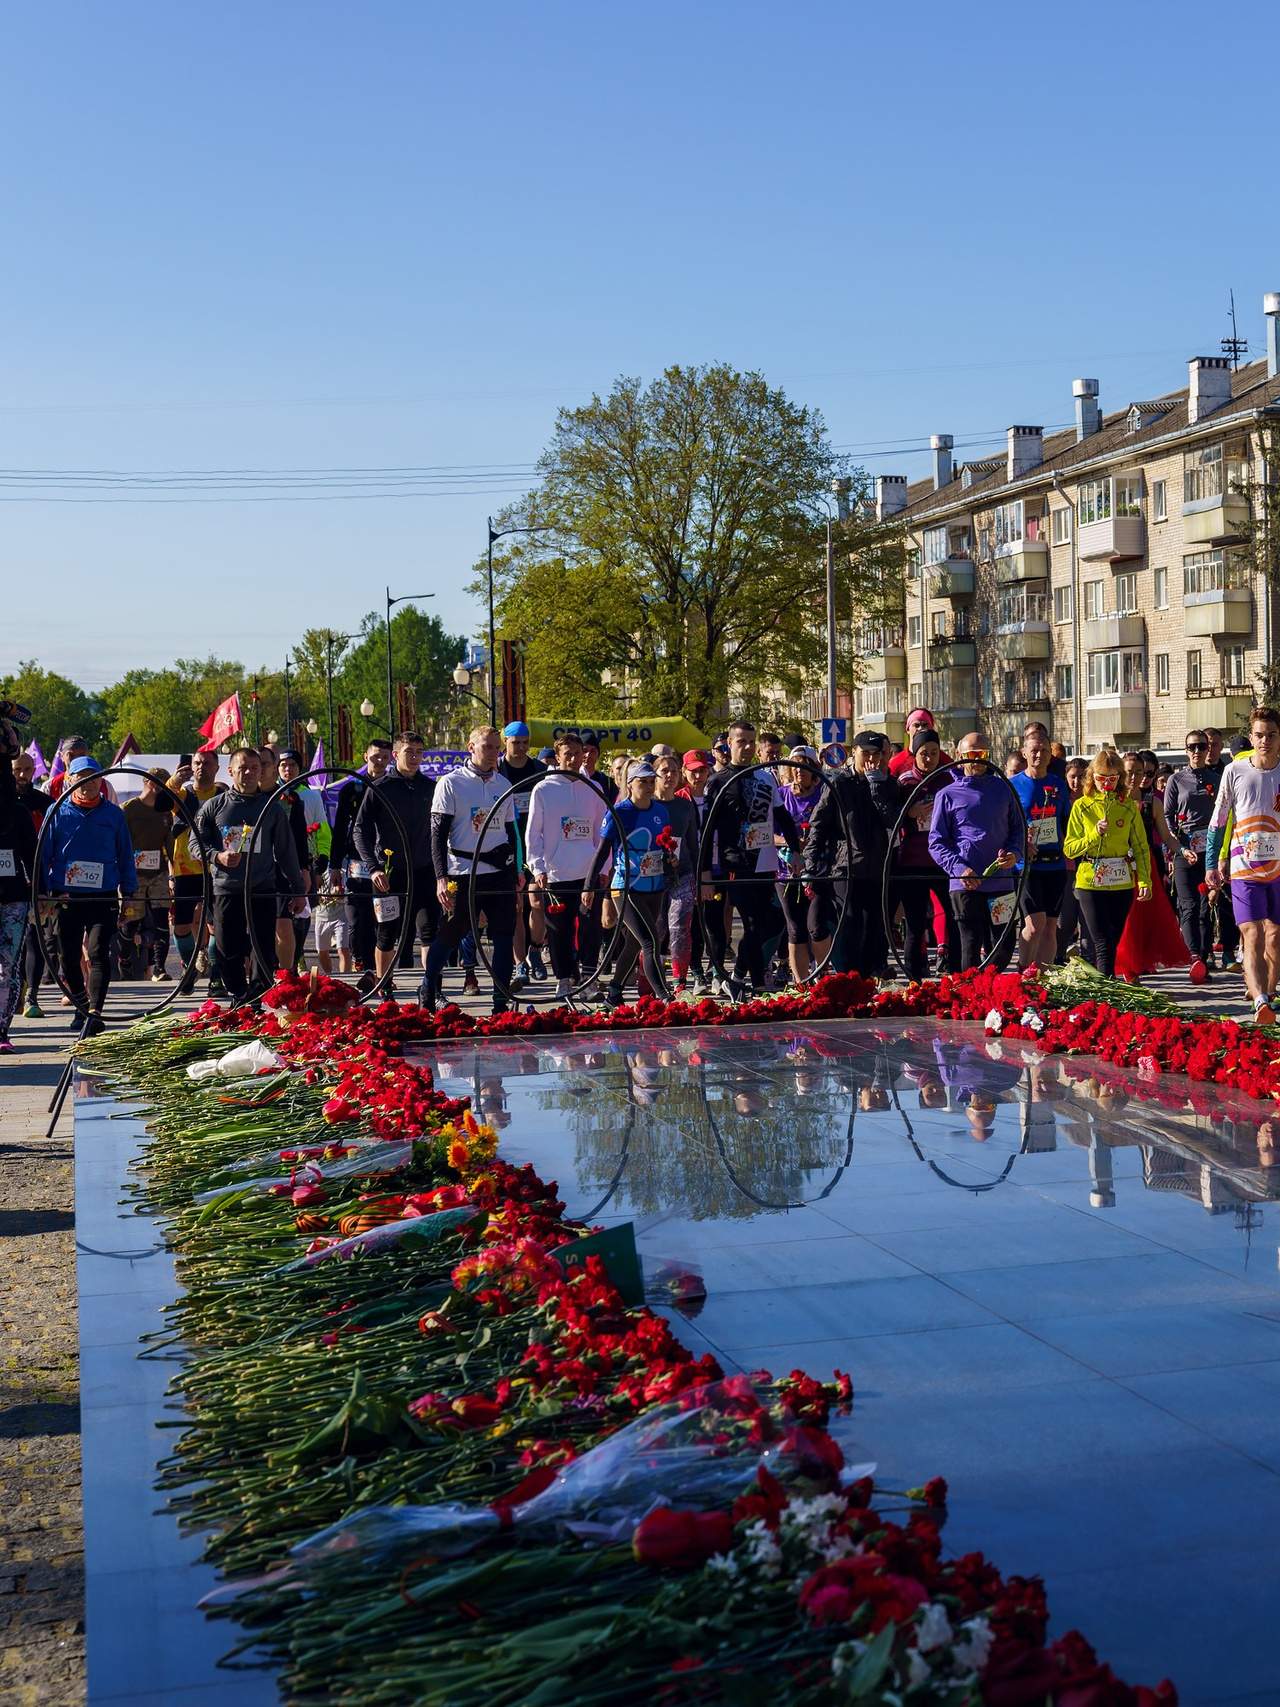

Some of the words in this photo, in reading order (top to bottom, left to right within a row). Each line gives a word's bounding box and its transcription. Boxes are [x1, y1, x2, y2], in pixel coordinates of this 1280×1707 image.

[626, 727, 652, 742] 40
[1043, 828, 1055, 836] 159
[1264, 844, 1275, 852] 16
[84, 872, 100, 881] 167
[386, 906, 395, 914] 54
